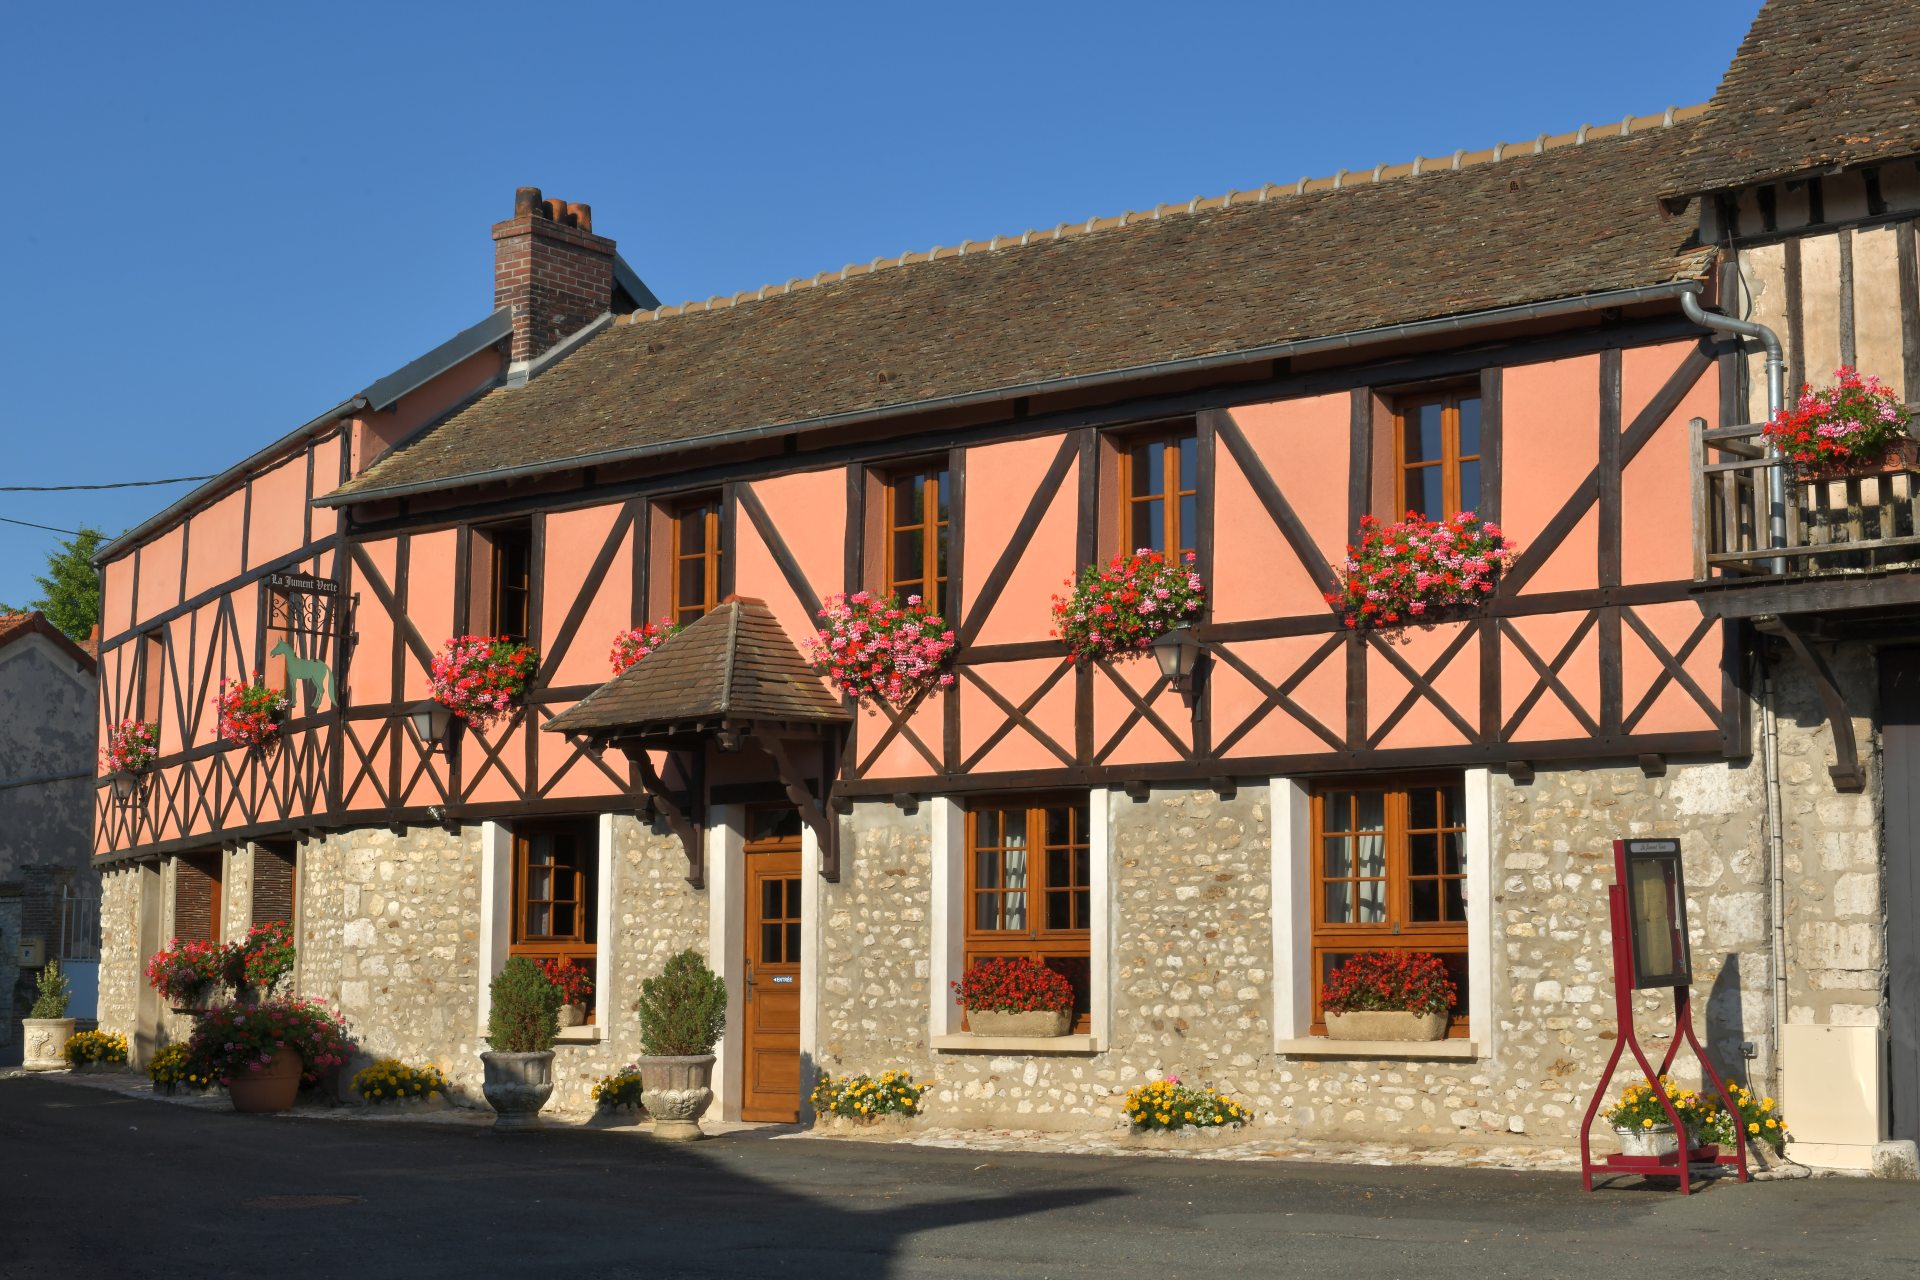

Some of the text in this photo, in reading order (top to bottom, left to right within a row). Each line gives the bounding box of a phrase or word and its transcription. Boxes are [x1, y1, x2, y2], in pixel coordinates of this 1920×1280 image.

[271, 574, 338, 592] La Jument Verte
